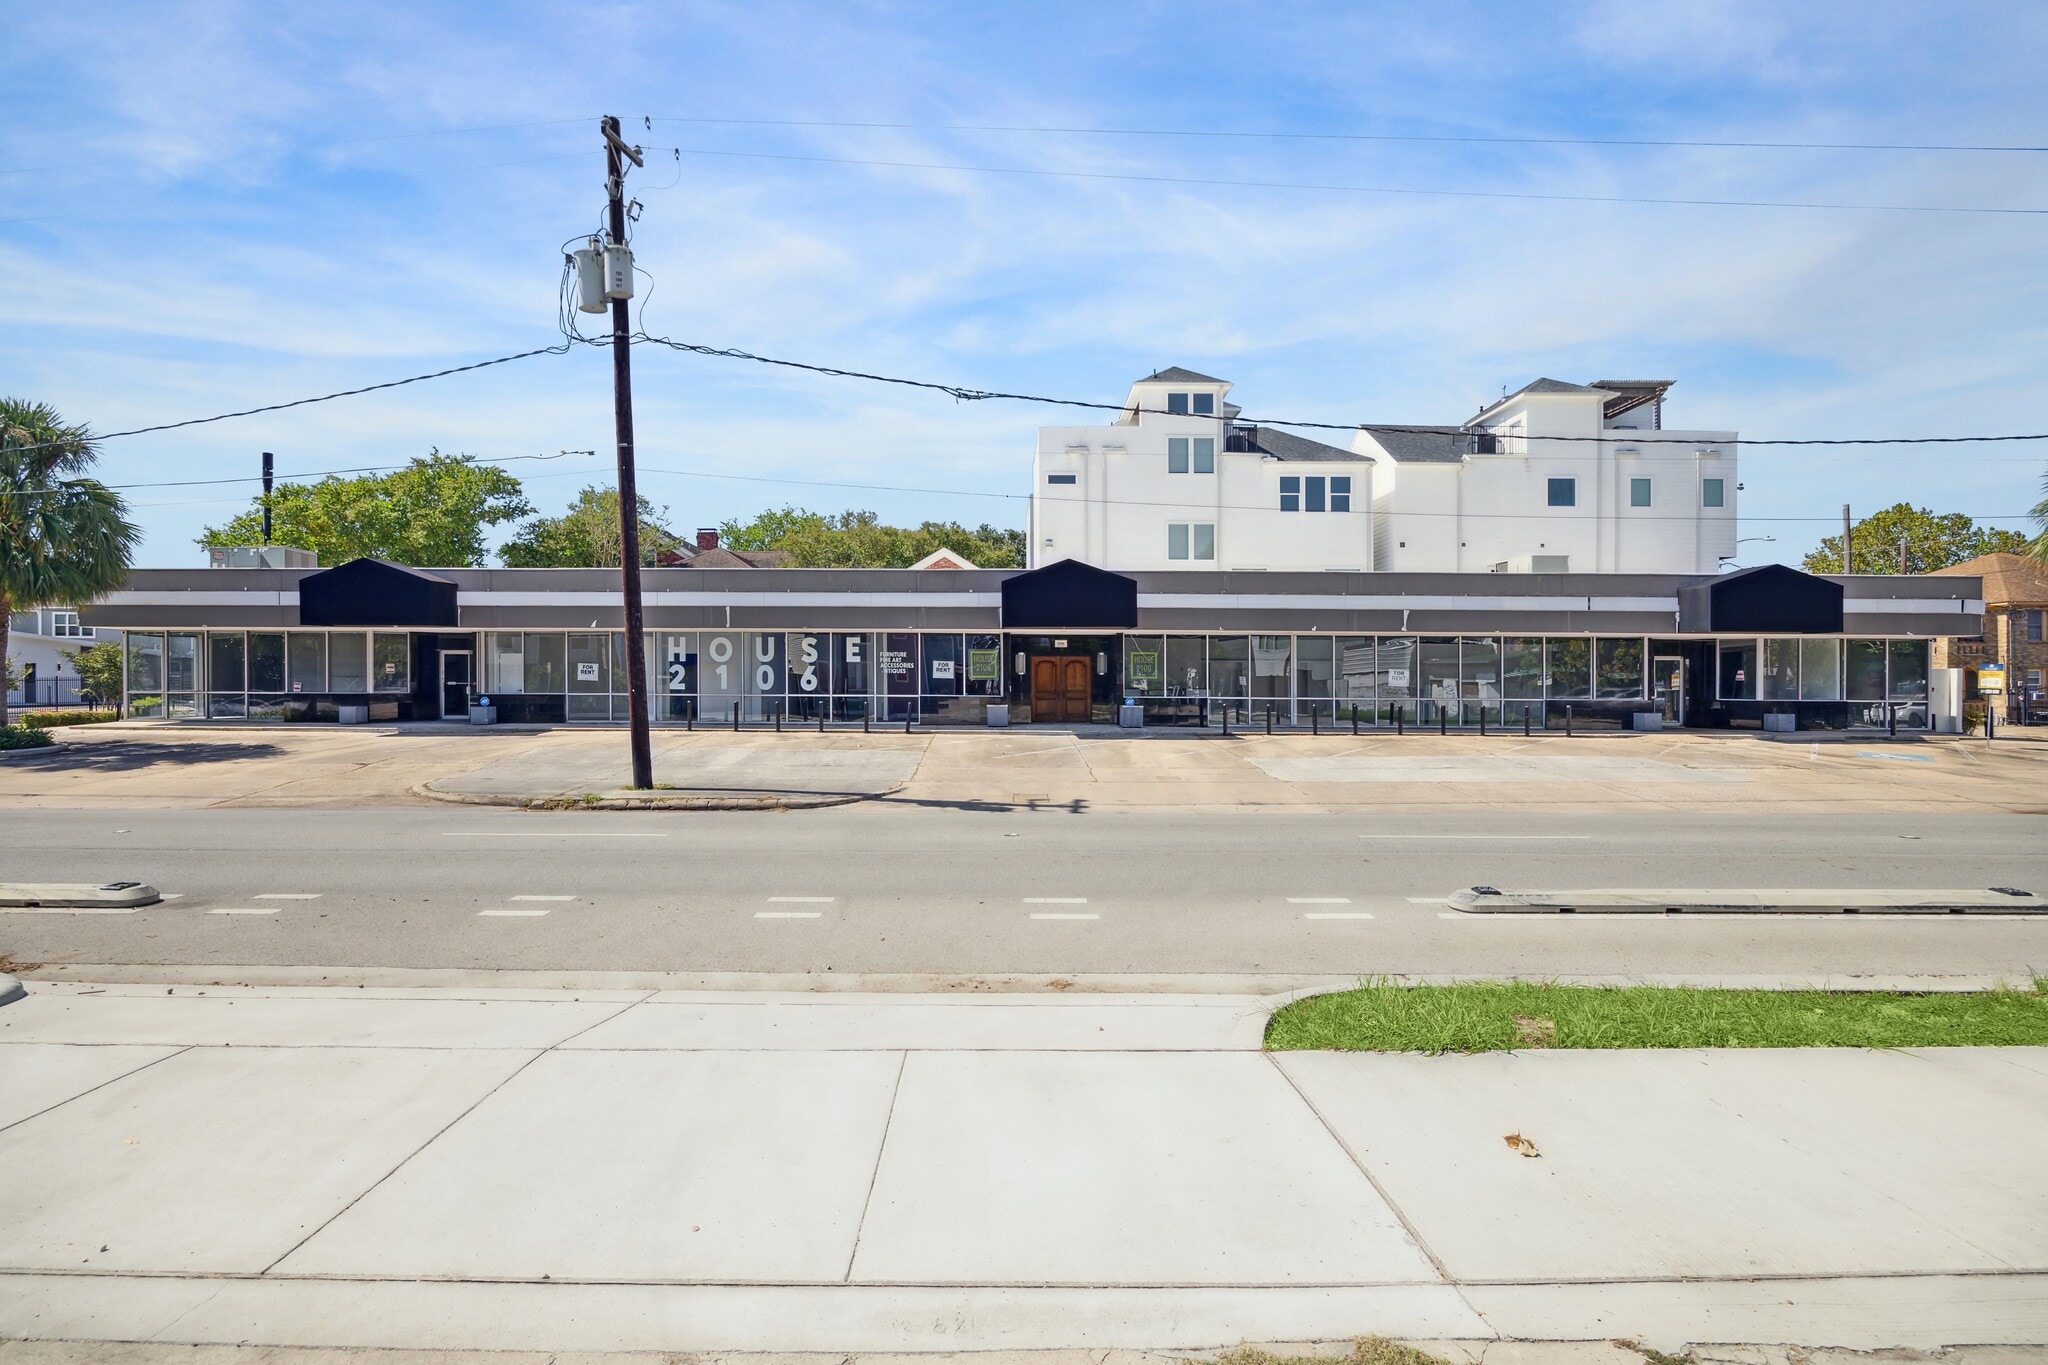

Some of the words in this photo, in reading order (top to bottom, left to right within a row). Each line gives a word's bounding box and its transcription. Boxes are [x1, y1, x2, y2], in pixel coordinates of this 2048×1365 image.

[667, 636, 861, 663] HOUSE
[973, 654, 994, 662] HOUSE
[668, 664, 818, 692] 2106
